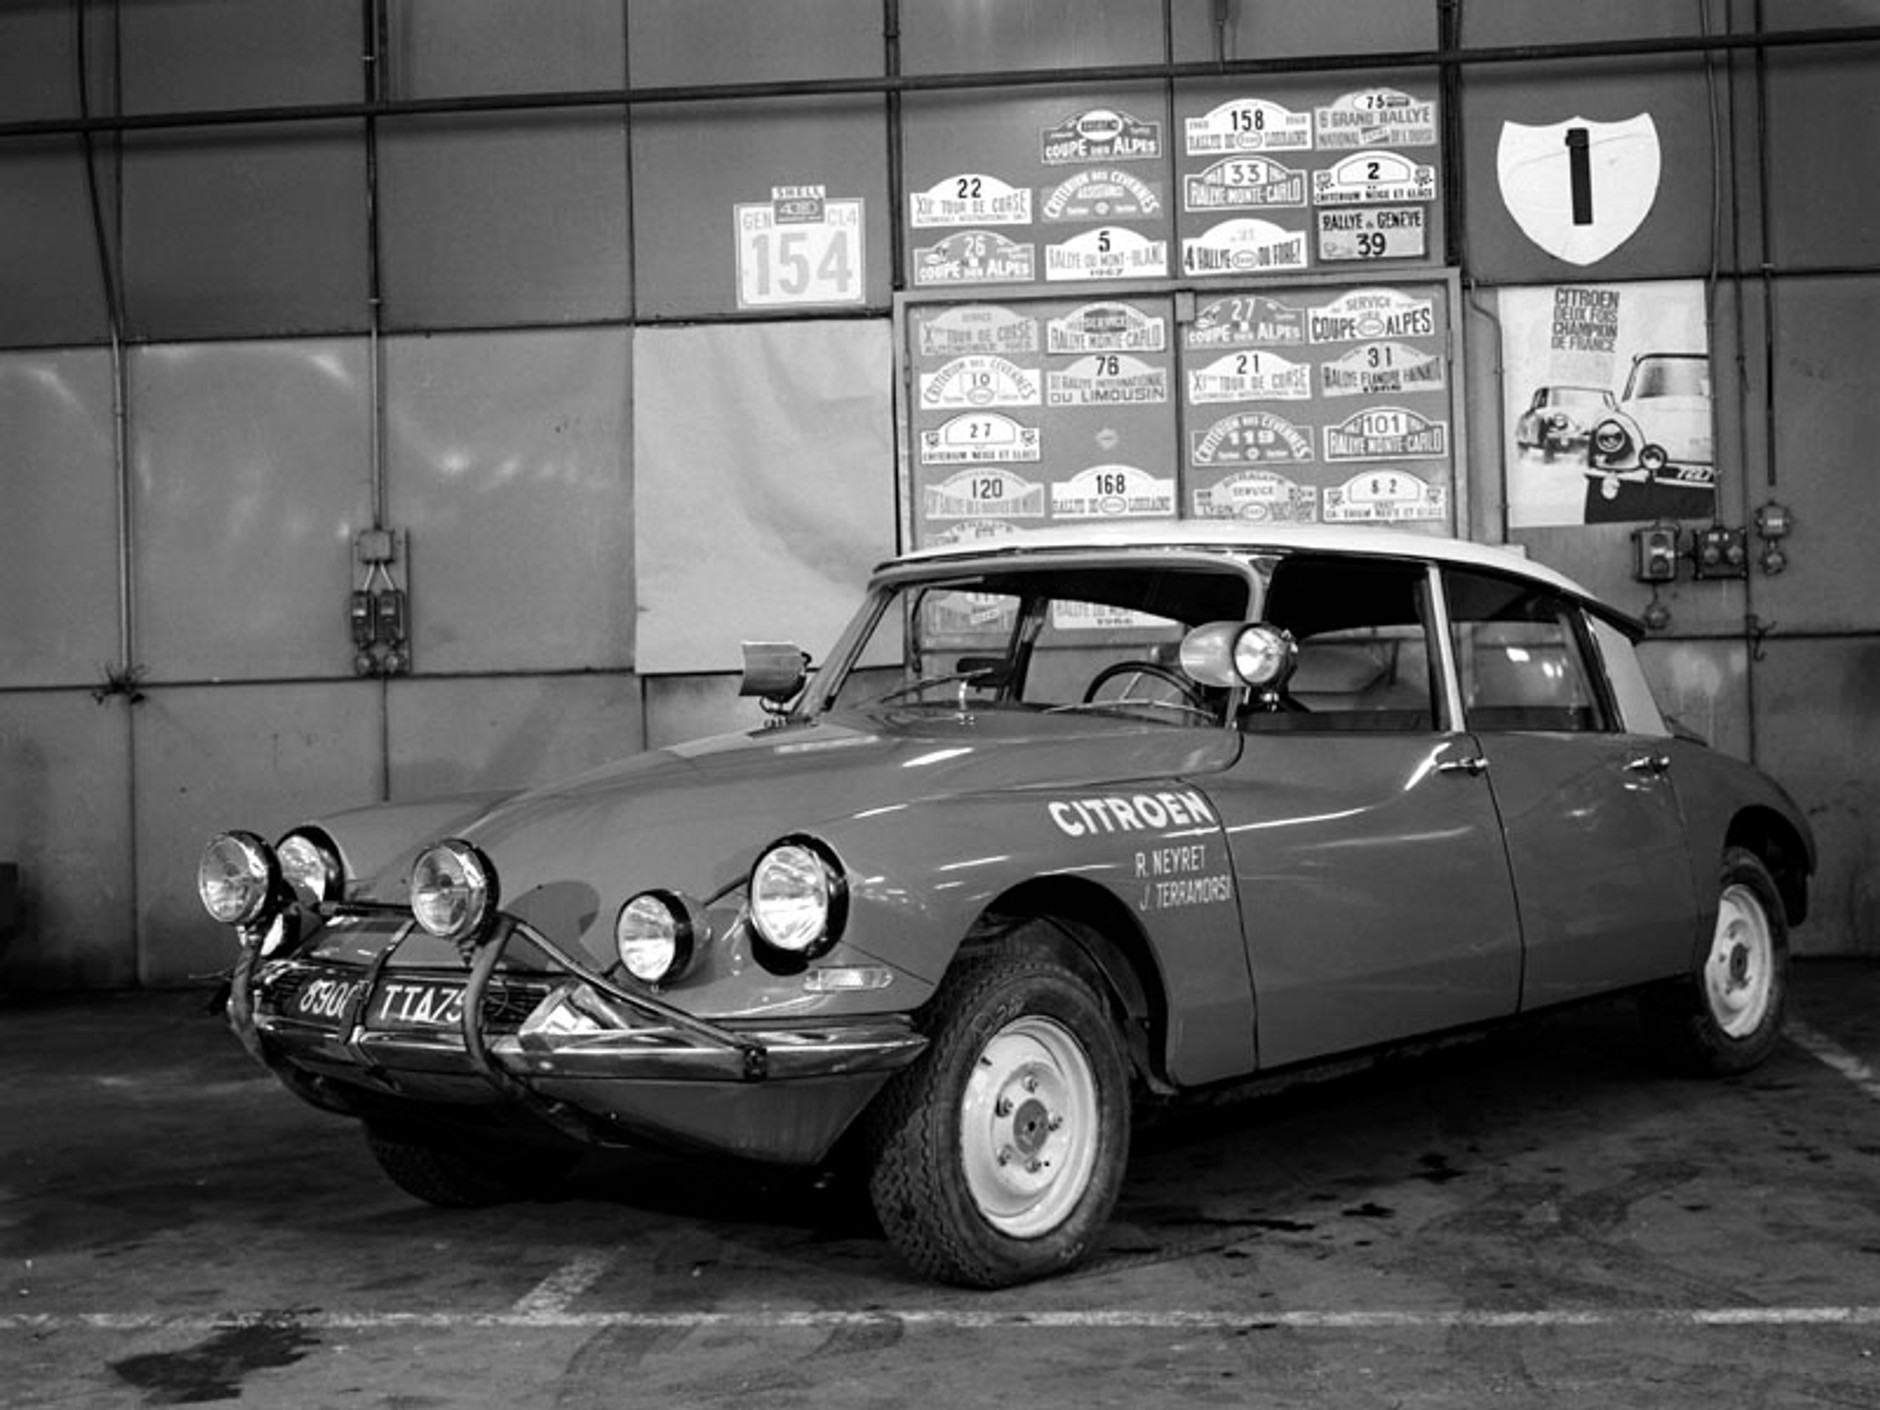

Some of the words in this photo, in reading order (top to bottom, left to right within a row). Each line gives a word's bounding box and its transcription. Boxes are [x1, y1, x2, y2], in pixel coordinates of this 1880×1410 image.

[1365, 94, 1386, 110] 75
[1230, 109, 1265, 132] 158
[1379, 105, 1432, 125] RALLYE
[1231, 164, 1261, 185] 33
[1367, 162, 1380, 181] 2
[1564, 127, 1594, 226] 1
[957, 178, 982, 199] 22
[1322, 211, 1364, 232] RALLYE
[963, 234, 987, 258] 26
[1097, 229, 1111, 252] 5
[1357, 232, 1387, 256] 39
[752, 230, 853, 295] 154
[1230, 297, 1257, 321] 27
[1311, 316, 1356, 342] COUPE
[1385, 307, 1431, 336] ALPES
[1236, 353, 1259, 376] 21
[1366, 345, 1393, 368] 31
[971, 371, 991, 388] 10
[1080, 386, 1165, 403] LIMOUSIN
[970, 422, 992, 439] 27
[1366, 414, 1401, 435] 101
[971, 478, 1003, 500] 120
[1096, 474, 1126, 495] 168
[1048, 790, 1216, 836] CITROEN
[1152, 844, 1206, 876] NEYRET
[1156, 874, 1232, 909] TERRAMORSI
